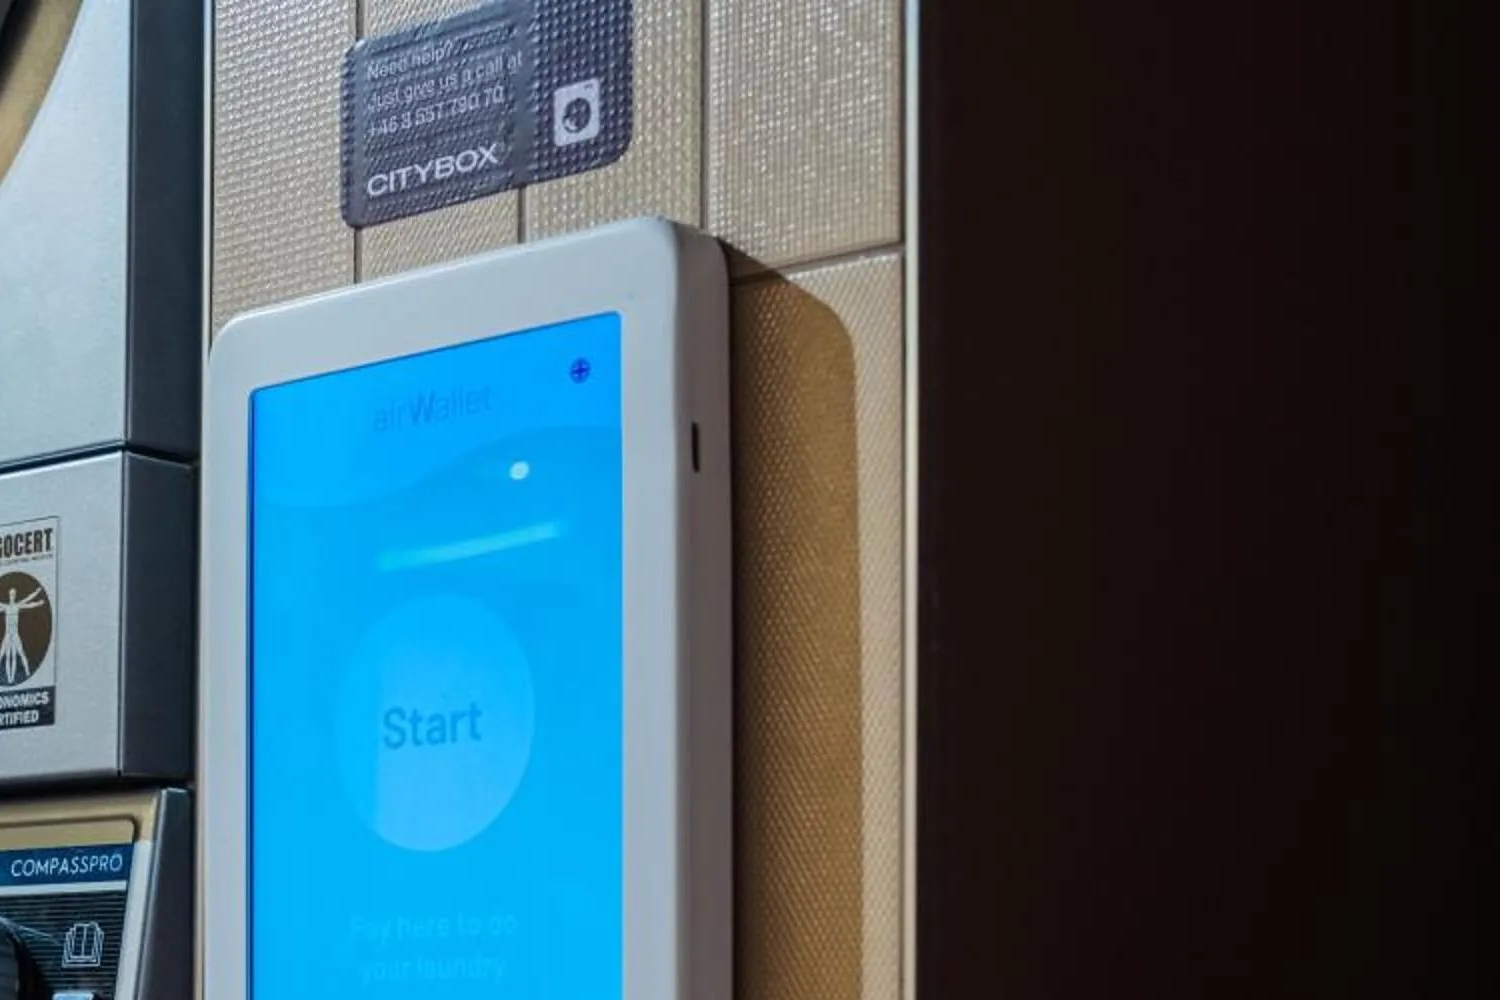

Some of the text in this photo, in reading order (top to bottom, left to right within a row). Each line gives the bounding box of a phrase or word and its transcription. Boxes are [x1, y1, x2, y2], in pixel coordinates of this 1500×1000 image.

[367, 143, 499, 198] CITYBOX
[372, 385, 492, 434] airWallet
[382, 701, 484, 750] Start
[11, 853, 123, 878] COMPASSPRO
